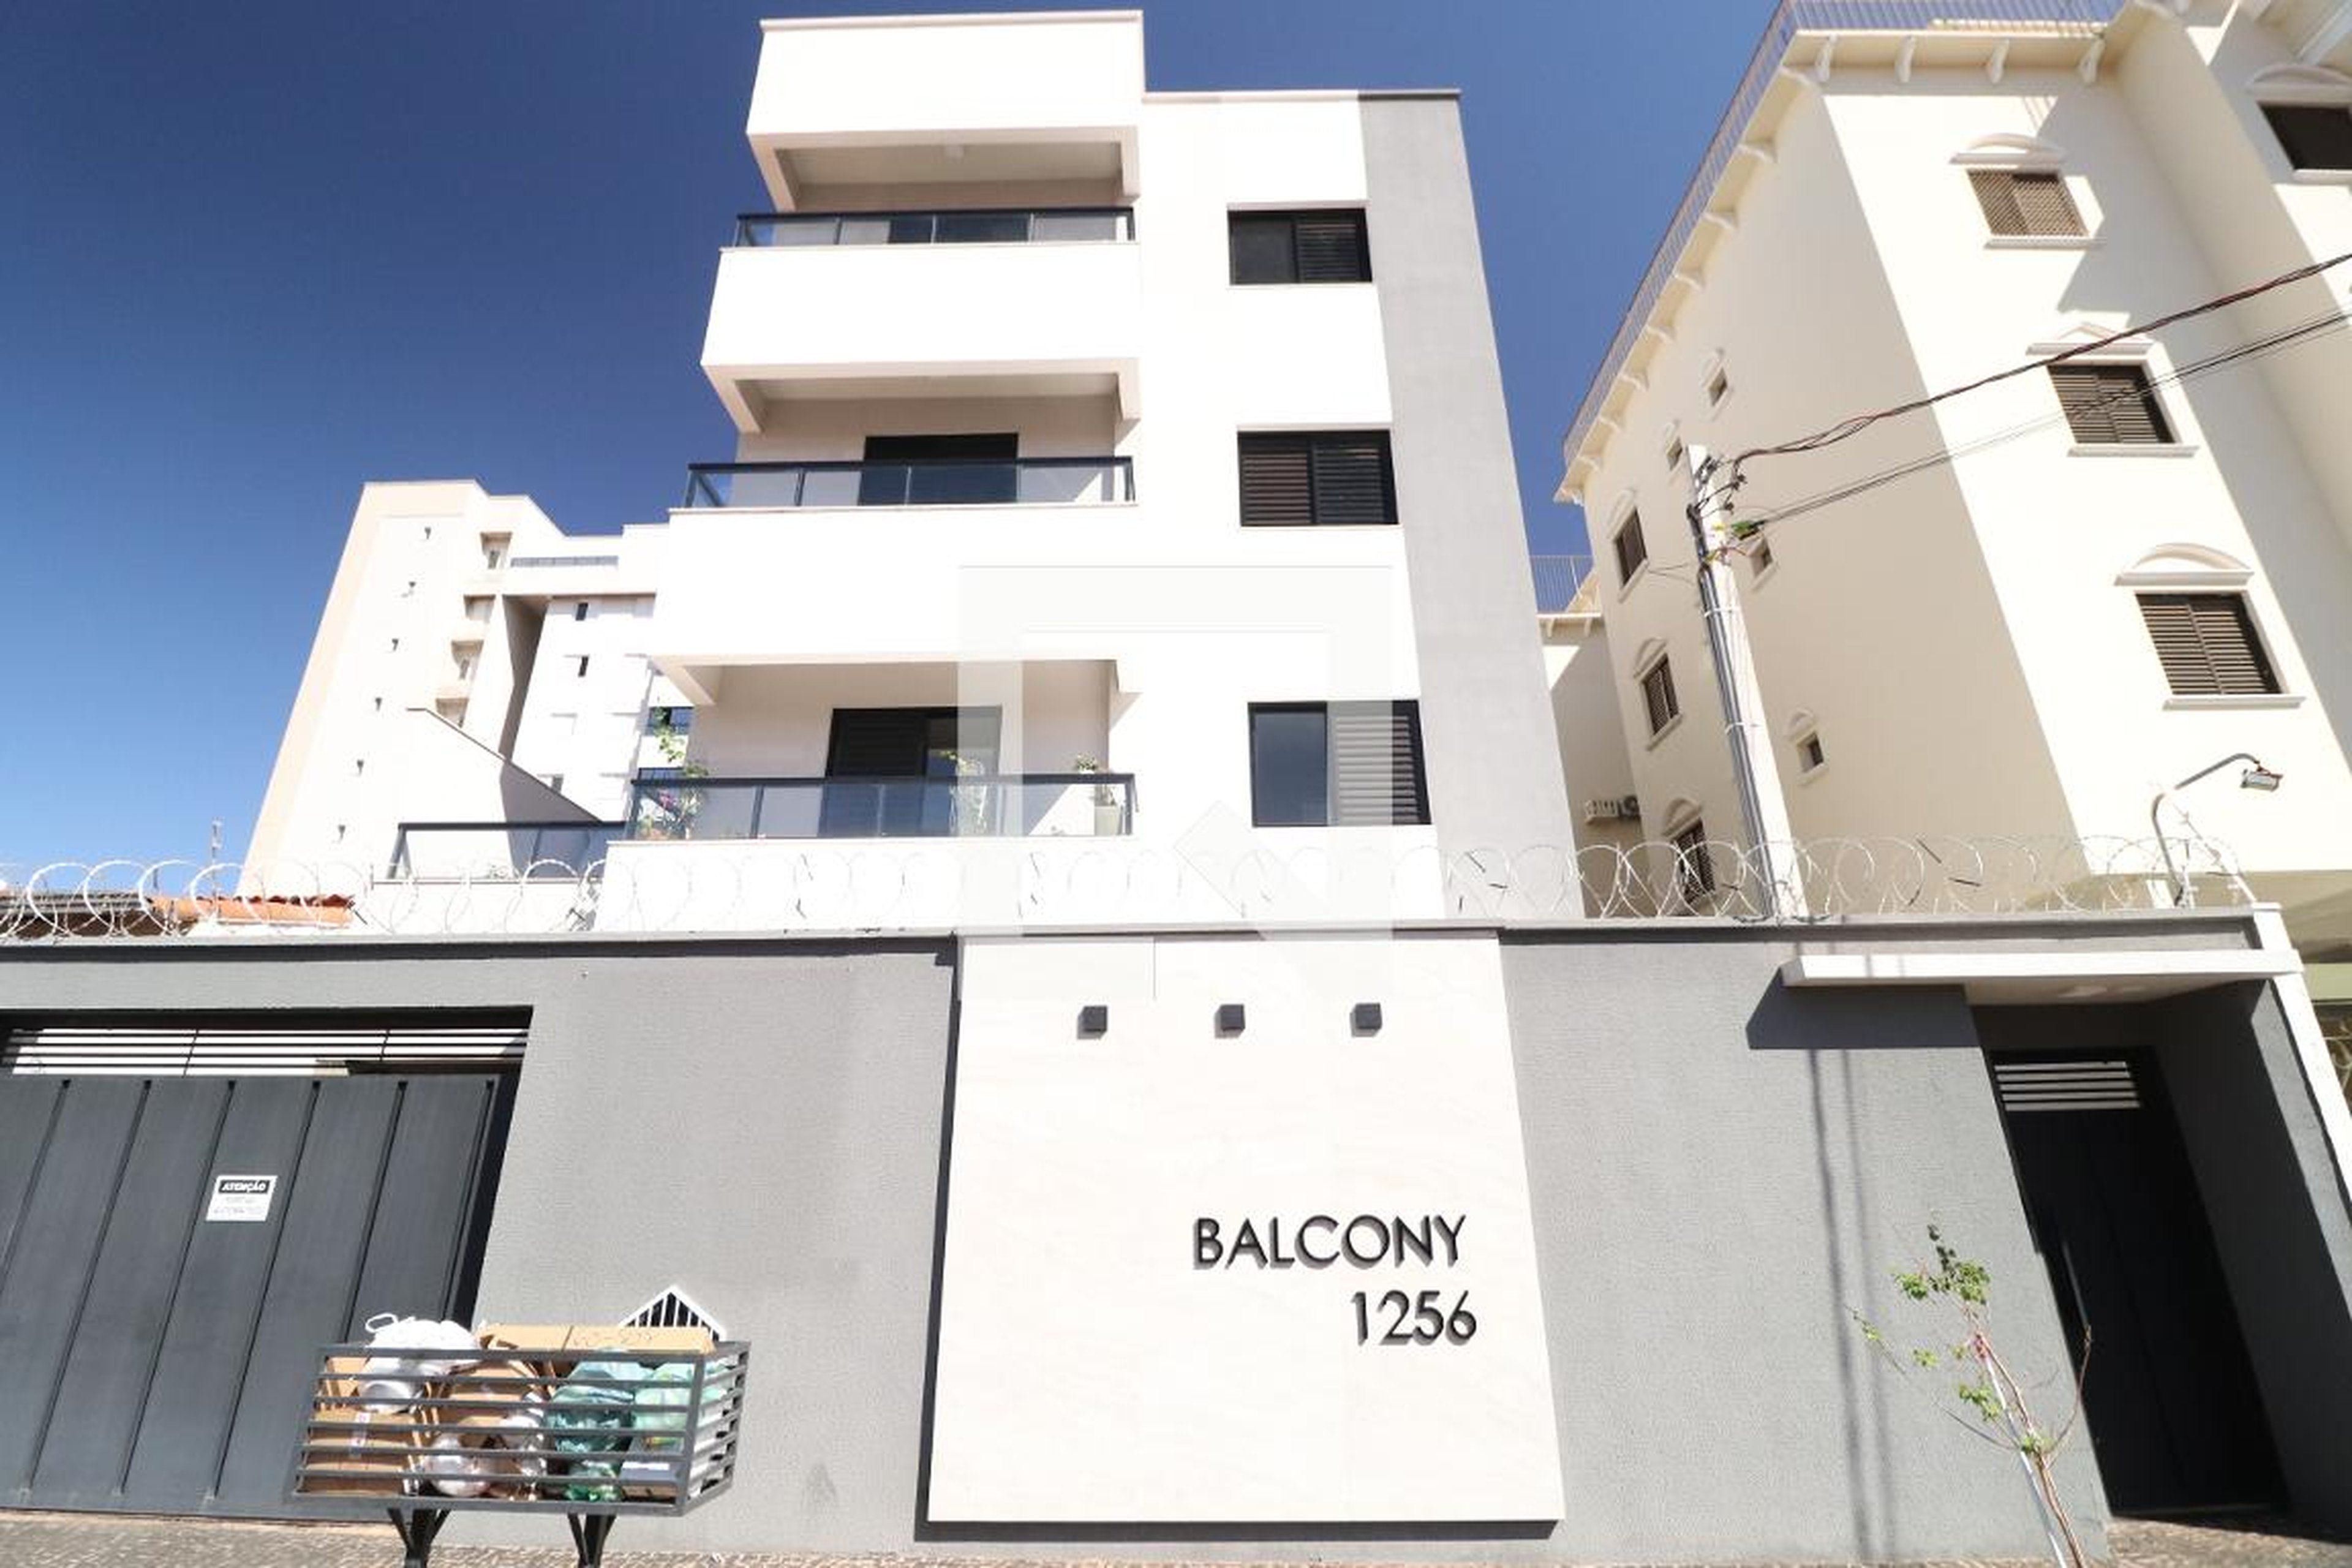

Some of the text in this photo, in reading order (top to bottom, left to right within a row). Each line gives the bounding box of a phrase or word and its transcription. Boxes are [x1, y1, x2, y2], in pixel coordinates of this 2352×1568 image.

[221, 1180, 266, 1193] ATENÇÃO
[1194, 1215, 1466, 1268] BALCONY
[1352, 1289, 1477, 1346] 1256
